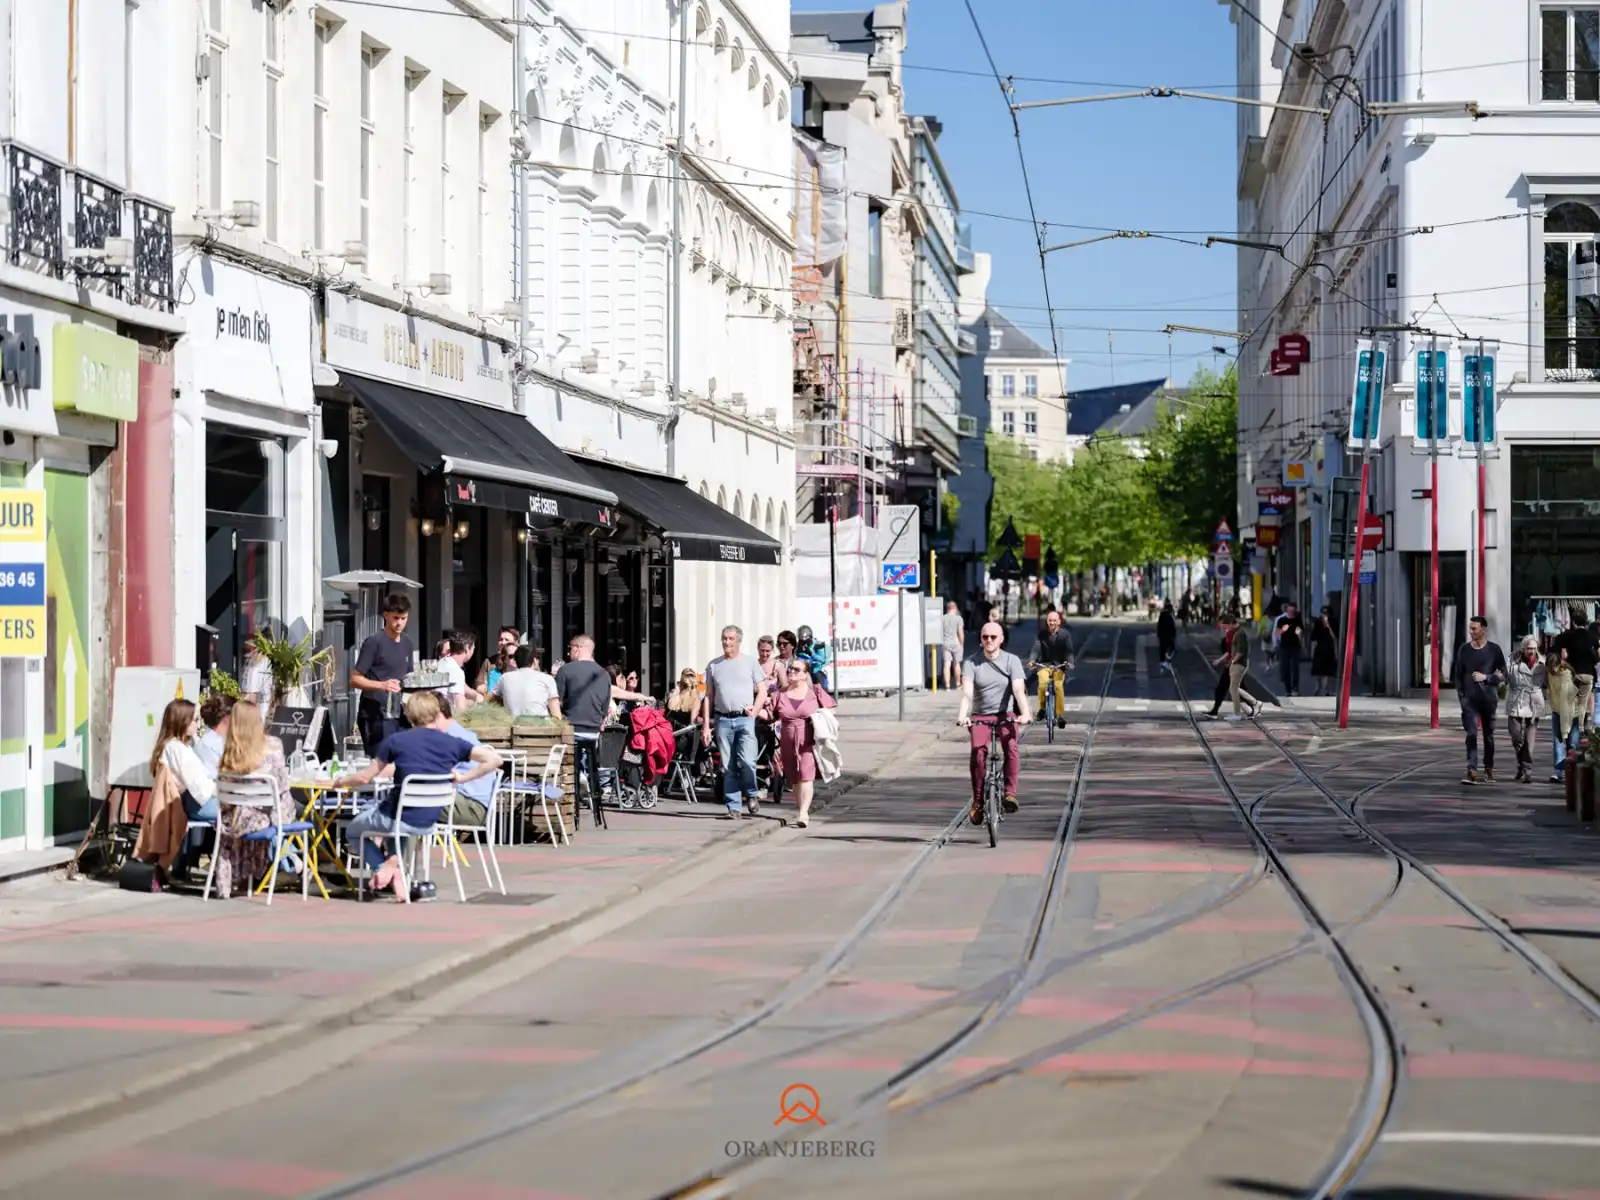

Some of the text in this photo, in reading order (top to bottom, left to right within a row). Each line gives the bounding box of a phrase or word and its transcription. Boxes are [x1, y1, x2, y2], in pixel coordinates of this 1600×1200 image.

[216, 306, 271, 345] je m'en fish
[384, 323, 420, 371] STELLA
[431, 338, 464, 382] ARTOIS
[18, 572, 35, 587] 45
